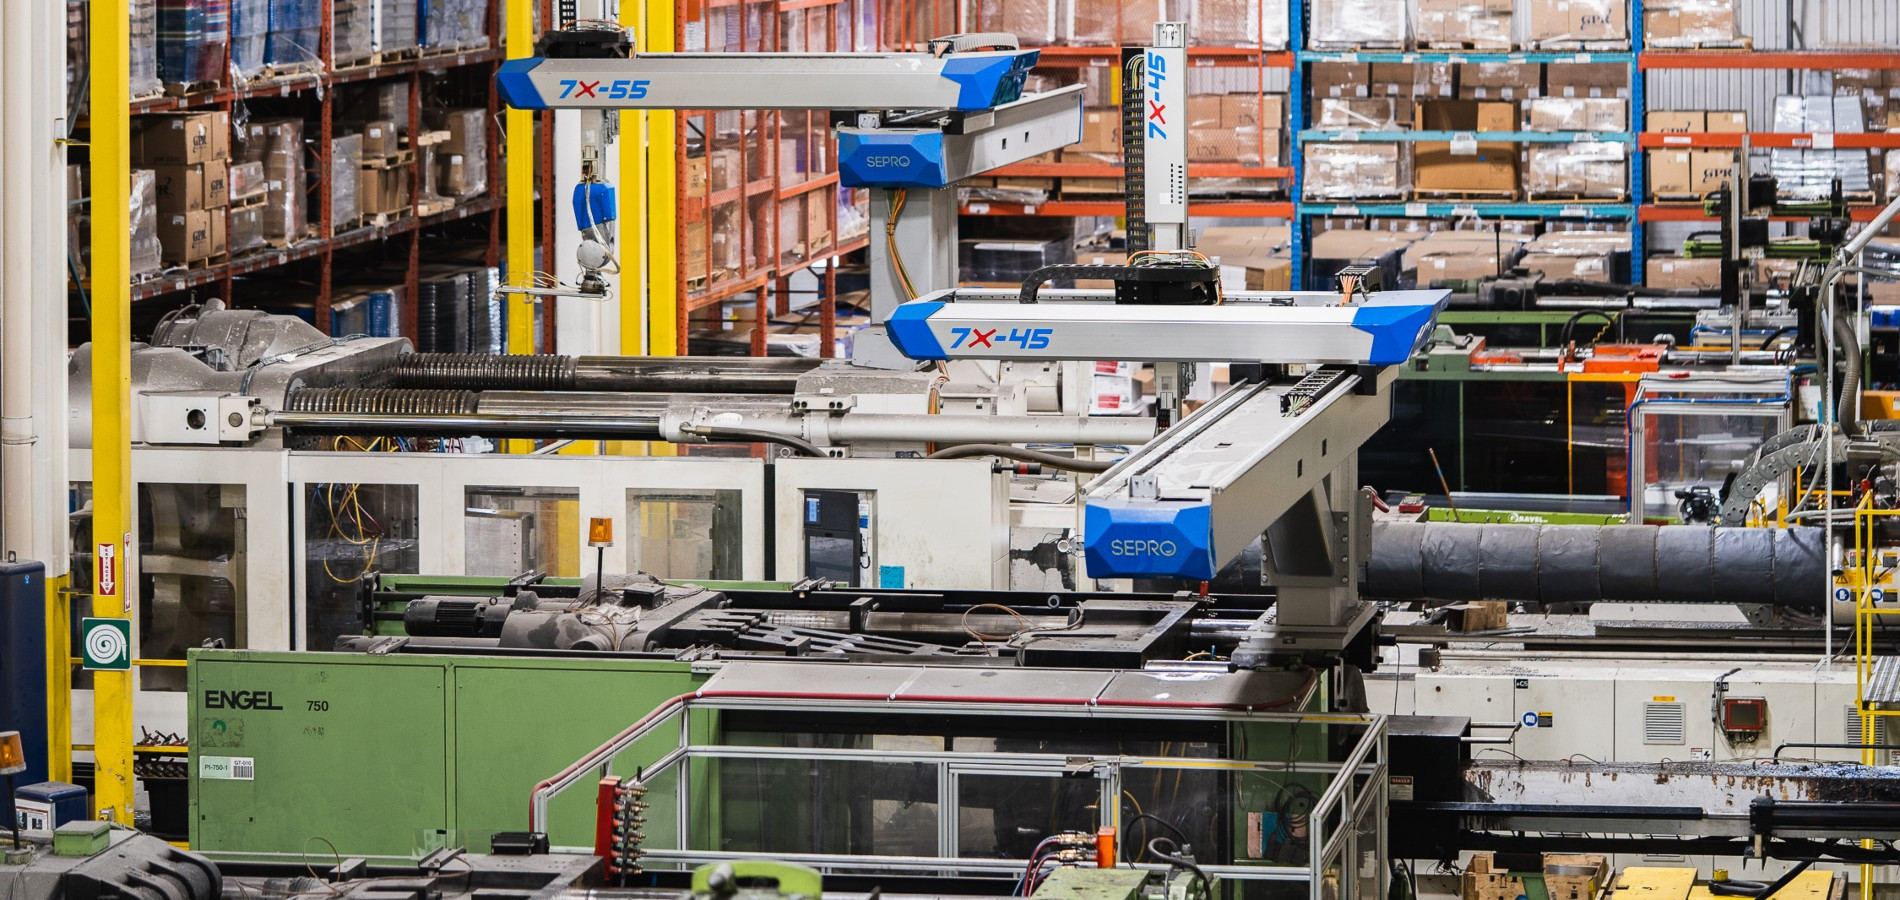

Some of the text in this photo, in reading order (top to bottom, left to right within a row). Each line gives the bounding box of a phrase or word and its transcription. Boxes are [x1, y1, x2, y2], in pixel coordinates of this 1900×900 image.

[559, 80, 651, 99] 7X-55
[1148, 52, 1167, 140] 7X-45
[866, 155, 911, 168] SEPRO
[950, 327, 1054, 349] 7X-45
[1111, 539, 1177, 557] SEPRO
[205, 690, 283, 710] ENGEL
[306, 700, 329, 711] 750
